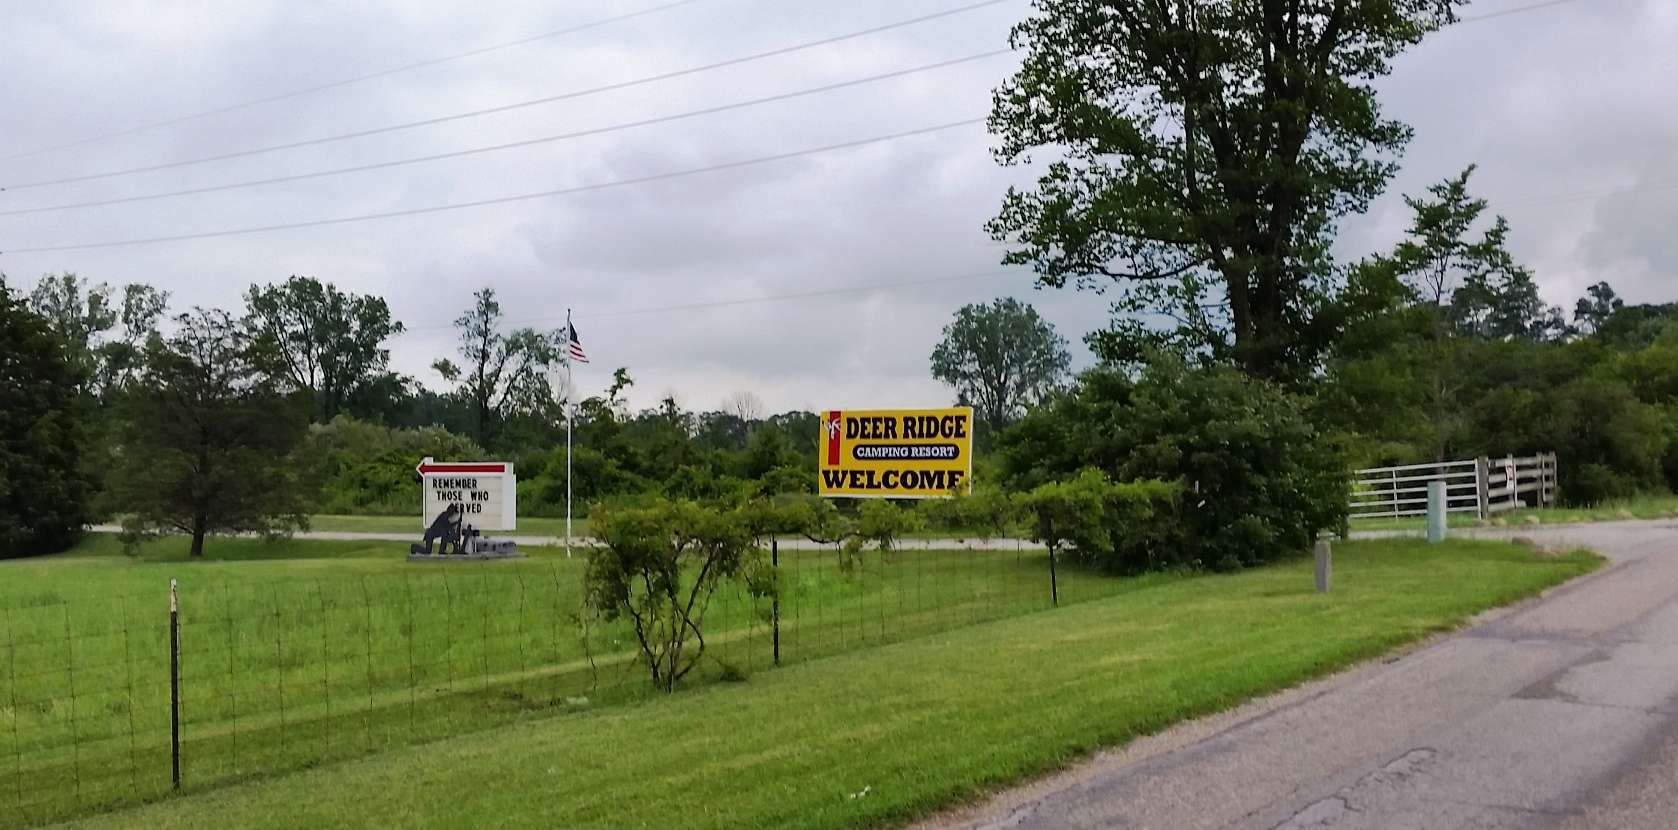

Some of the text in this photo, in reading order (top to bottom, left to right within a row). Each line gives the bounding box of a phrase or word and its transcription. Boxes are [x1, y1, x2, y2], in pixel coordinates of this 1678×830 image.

[846, 415, 966, 439] DEER RIDGE
[857, 446, 955, 458] CAMPING RESORT
[432, 478, 477, 489] REMEMBER
[437, 490, 489, 501] THOSE WHO
[449, 503, 482, 513] ERVED
